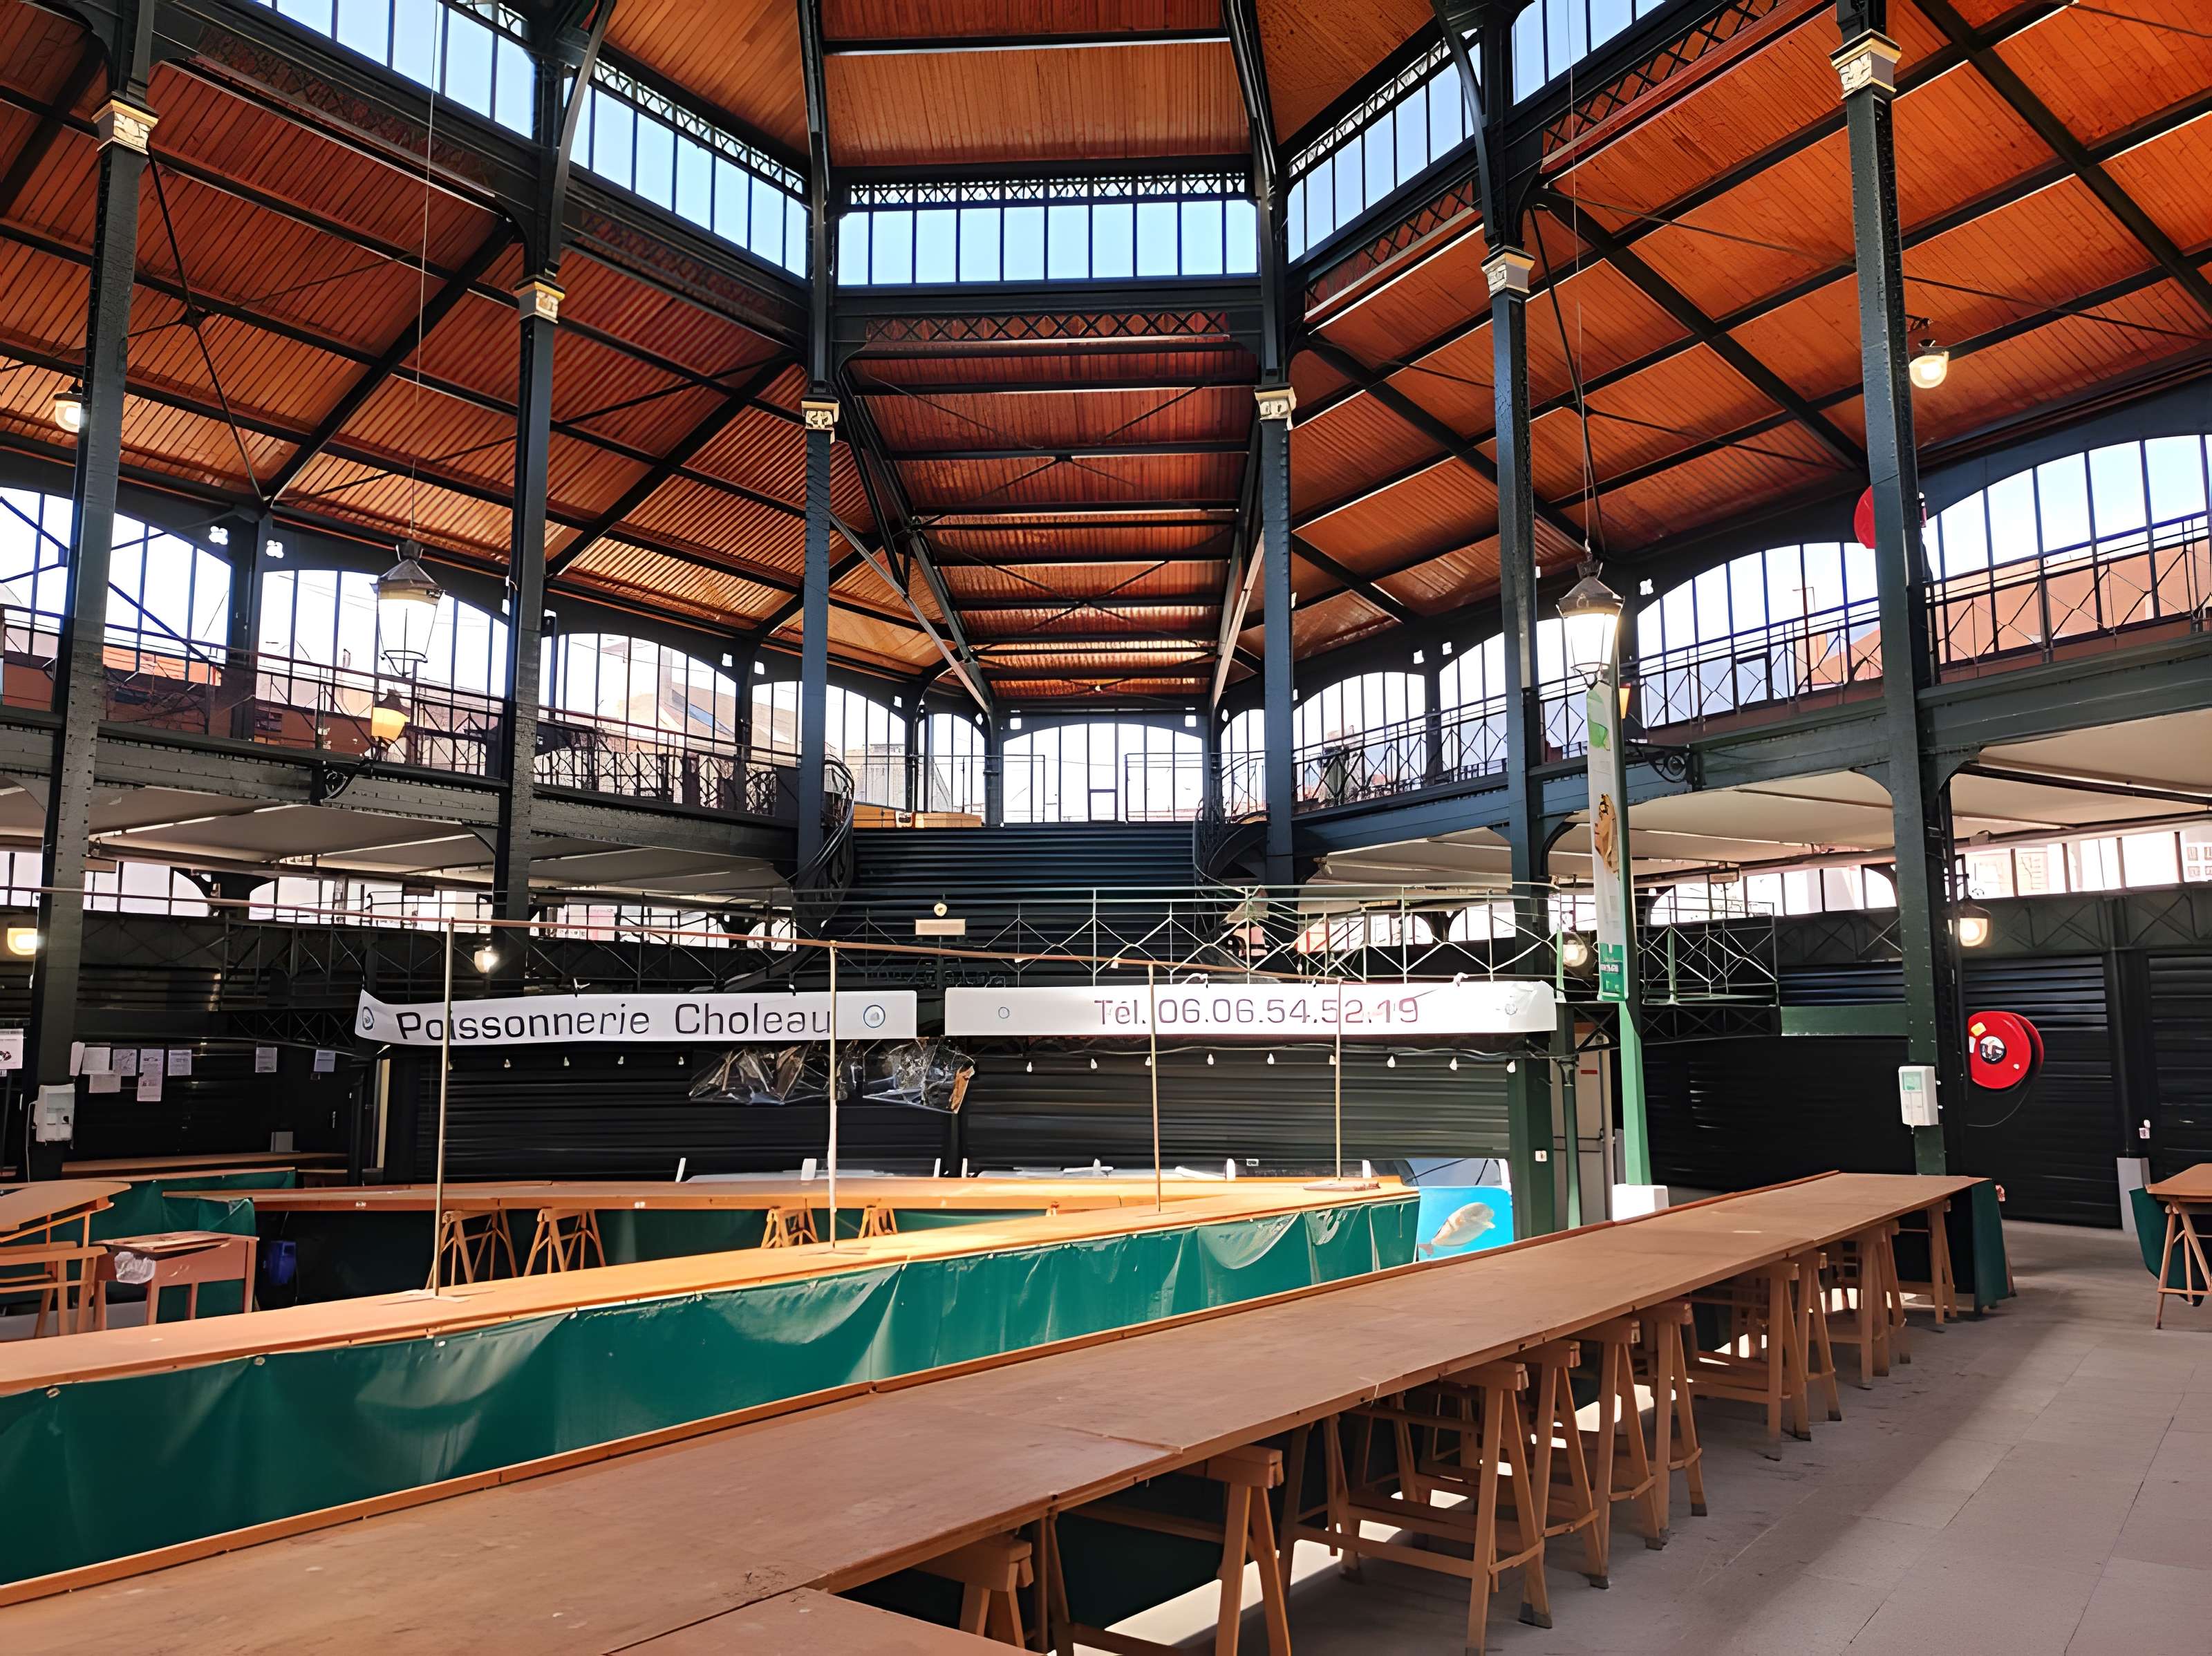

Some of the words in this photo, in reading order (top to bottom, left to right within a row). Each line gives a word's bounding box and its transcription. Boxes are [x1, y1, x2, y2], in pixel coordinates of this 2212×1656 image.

[396, 1003, 650, 1040] Poissonnerie
[675, 1002, 832, 1034] Choleau
[1094, 999, 1146, 1025] Tél.
[1159, 997, 1418, 1024] 06.06.54.52.19
